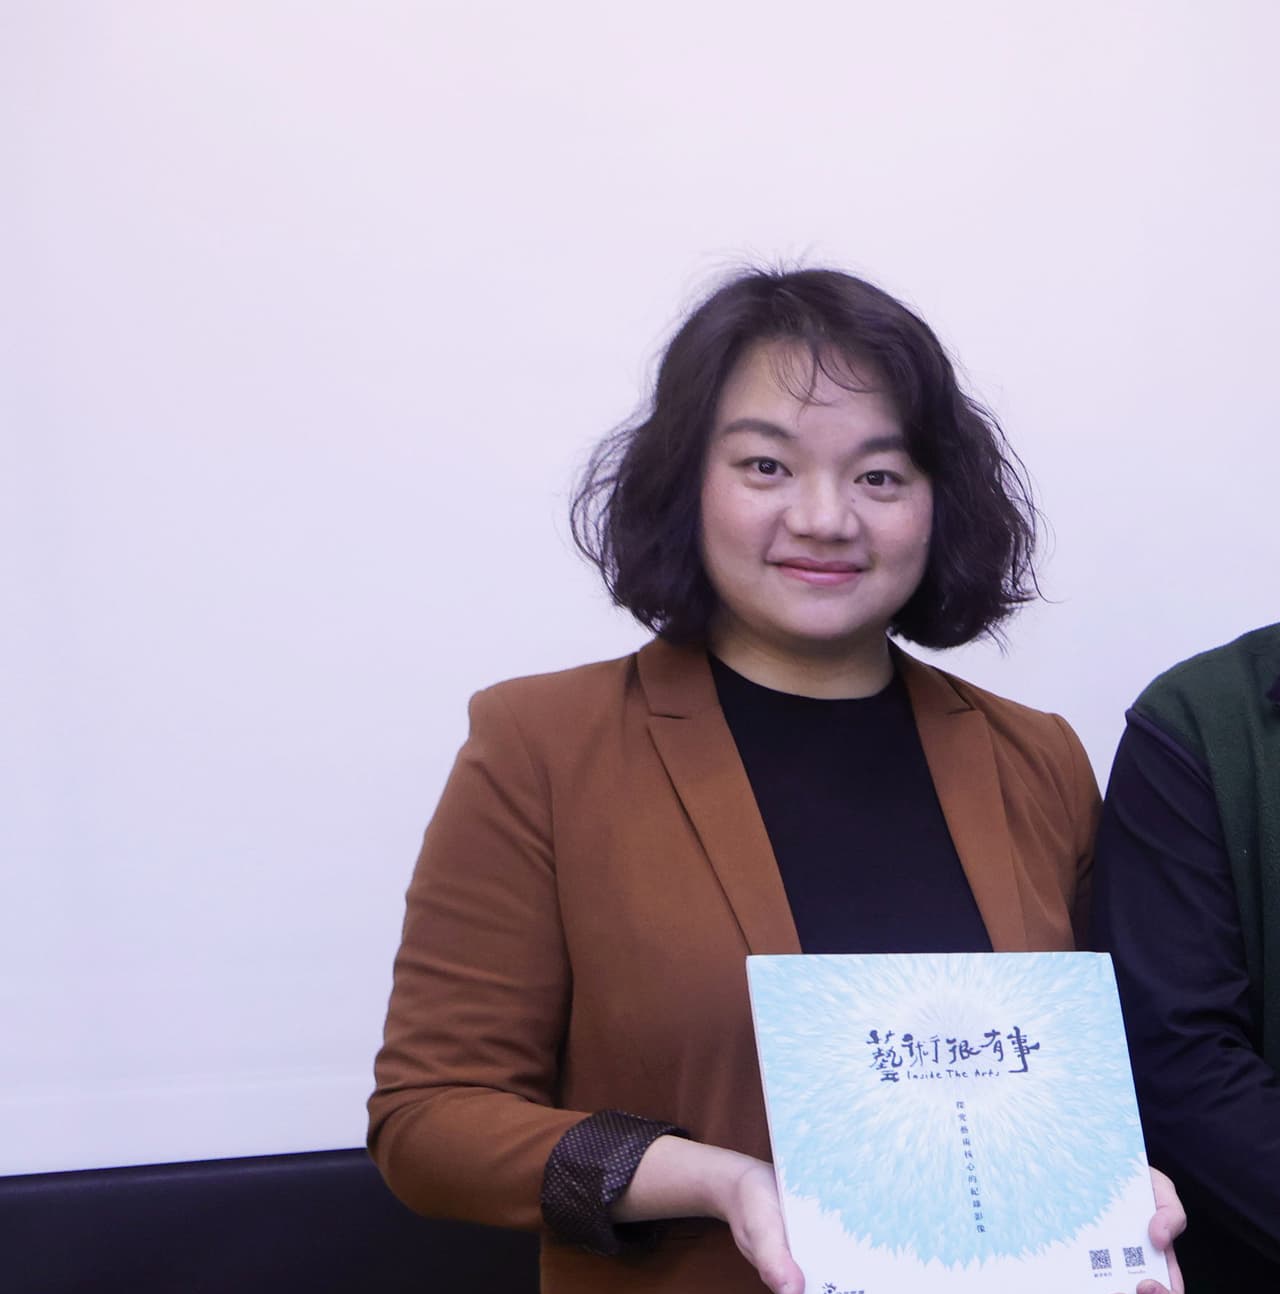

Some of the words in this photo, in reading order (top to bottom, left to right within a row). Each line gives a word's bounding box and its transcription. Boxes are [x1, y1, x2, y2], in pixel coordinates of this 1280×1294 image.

[866, 1026, 1041, 1083] 藝術很有事
